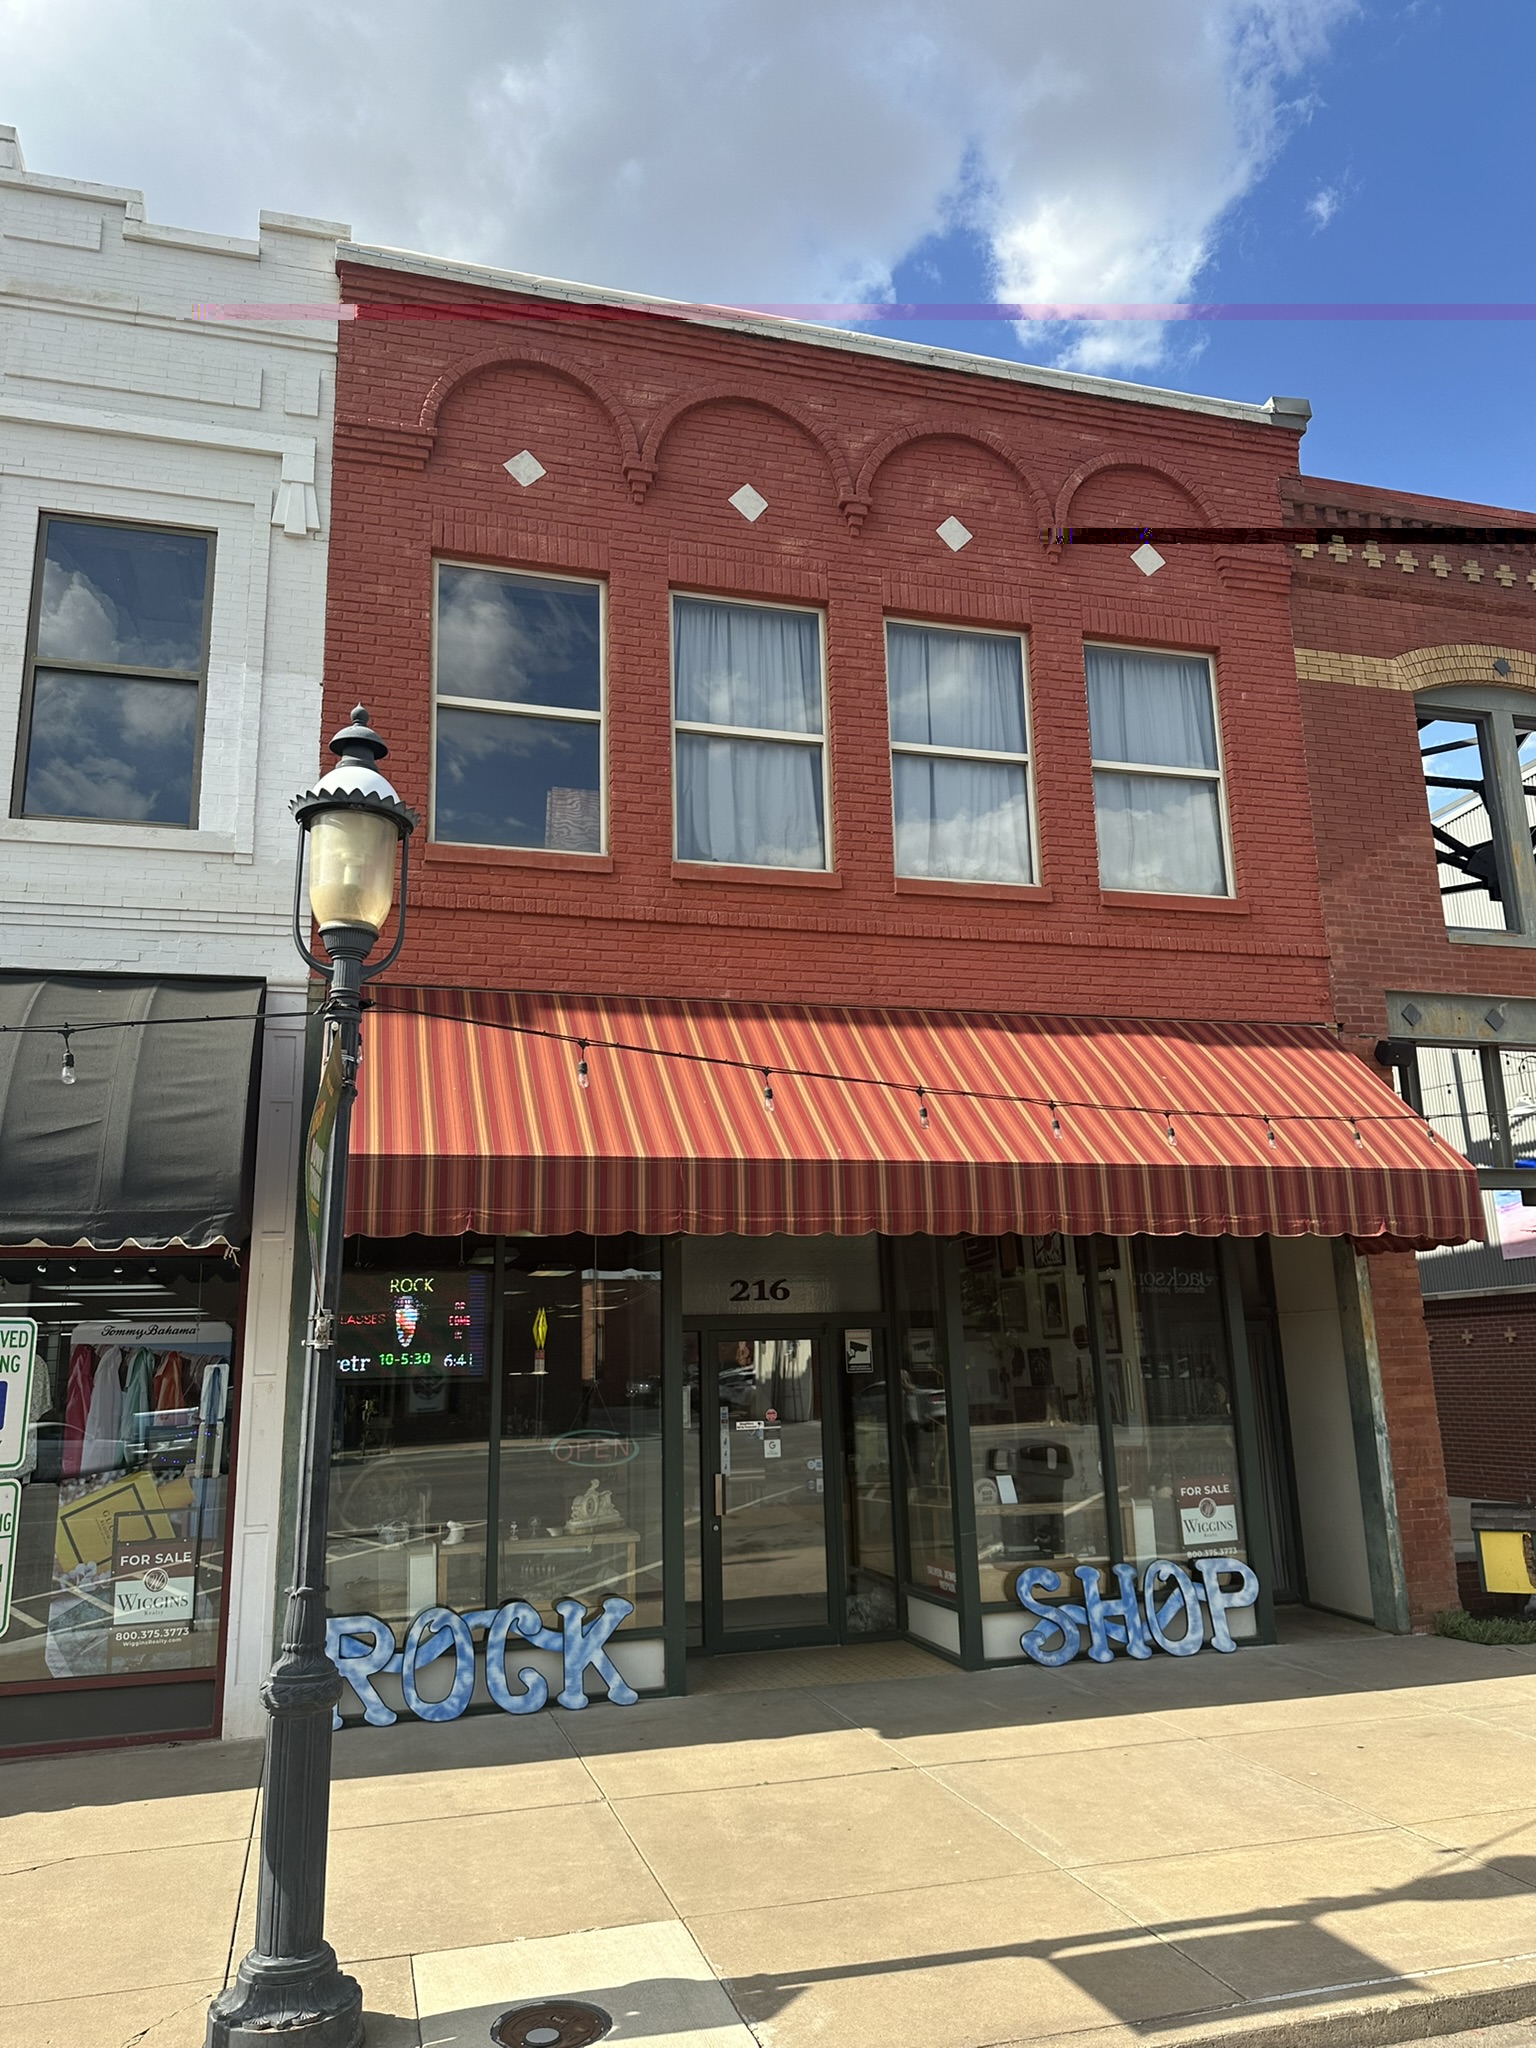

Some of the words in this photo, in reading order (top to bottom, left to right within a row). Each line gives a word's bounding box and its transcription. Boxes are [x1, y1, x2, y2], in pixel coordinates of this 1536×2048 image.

[389, 1277, 435, 1294] ROCK
[728, 1278, 791, 1302] 216
[338, 1312, 387, 1326] LASSES
[101, 1324, 145, 1340] Tommy
[144, 1324, 198, 1336] Bahama
[378, 1352, 432, 1366] 10-5:30
[554, 1436, 630, 1462] OPEN
[1179, 1486, 1203, 1498] FOR
[1203, 1483, 1231, 1496] SALE
[1183, 1518, 1234, 1534] WIGGINS
[120, 1554, 150, 1567] FOR
[154, 1551, 192, 1564] SALE
[1186, 1546, 1238, 1559] 800.375.3773
[118, 1593, 189, 1611] WIGGINS
[1015, 1558, 1260, 1667] SHOP
[115, 1626, 191, 1641] 800.375.3773
[122, 1637, 183, 1648] WigginsRealty.com
[326, 1596, 639, 1730] ROCK
